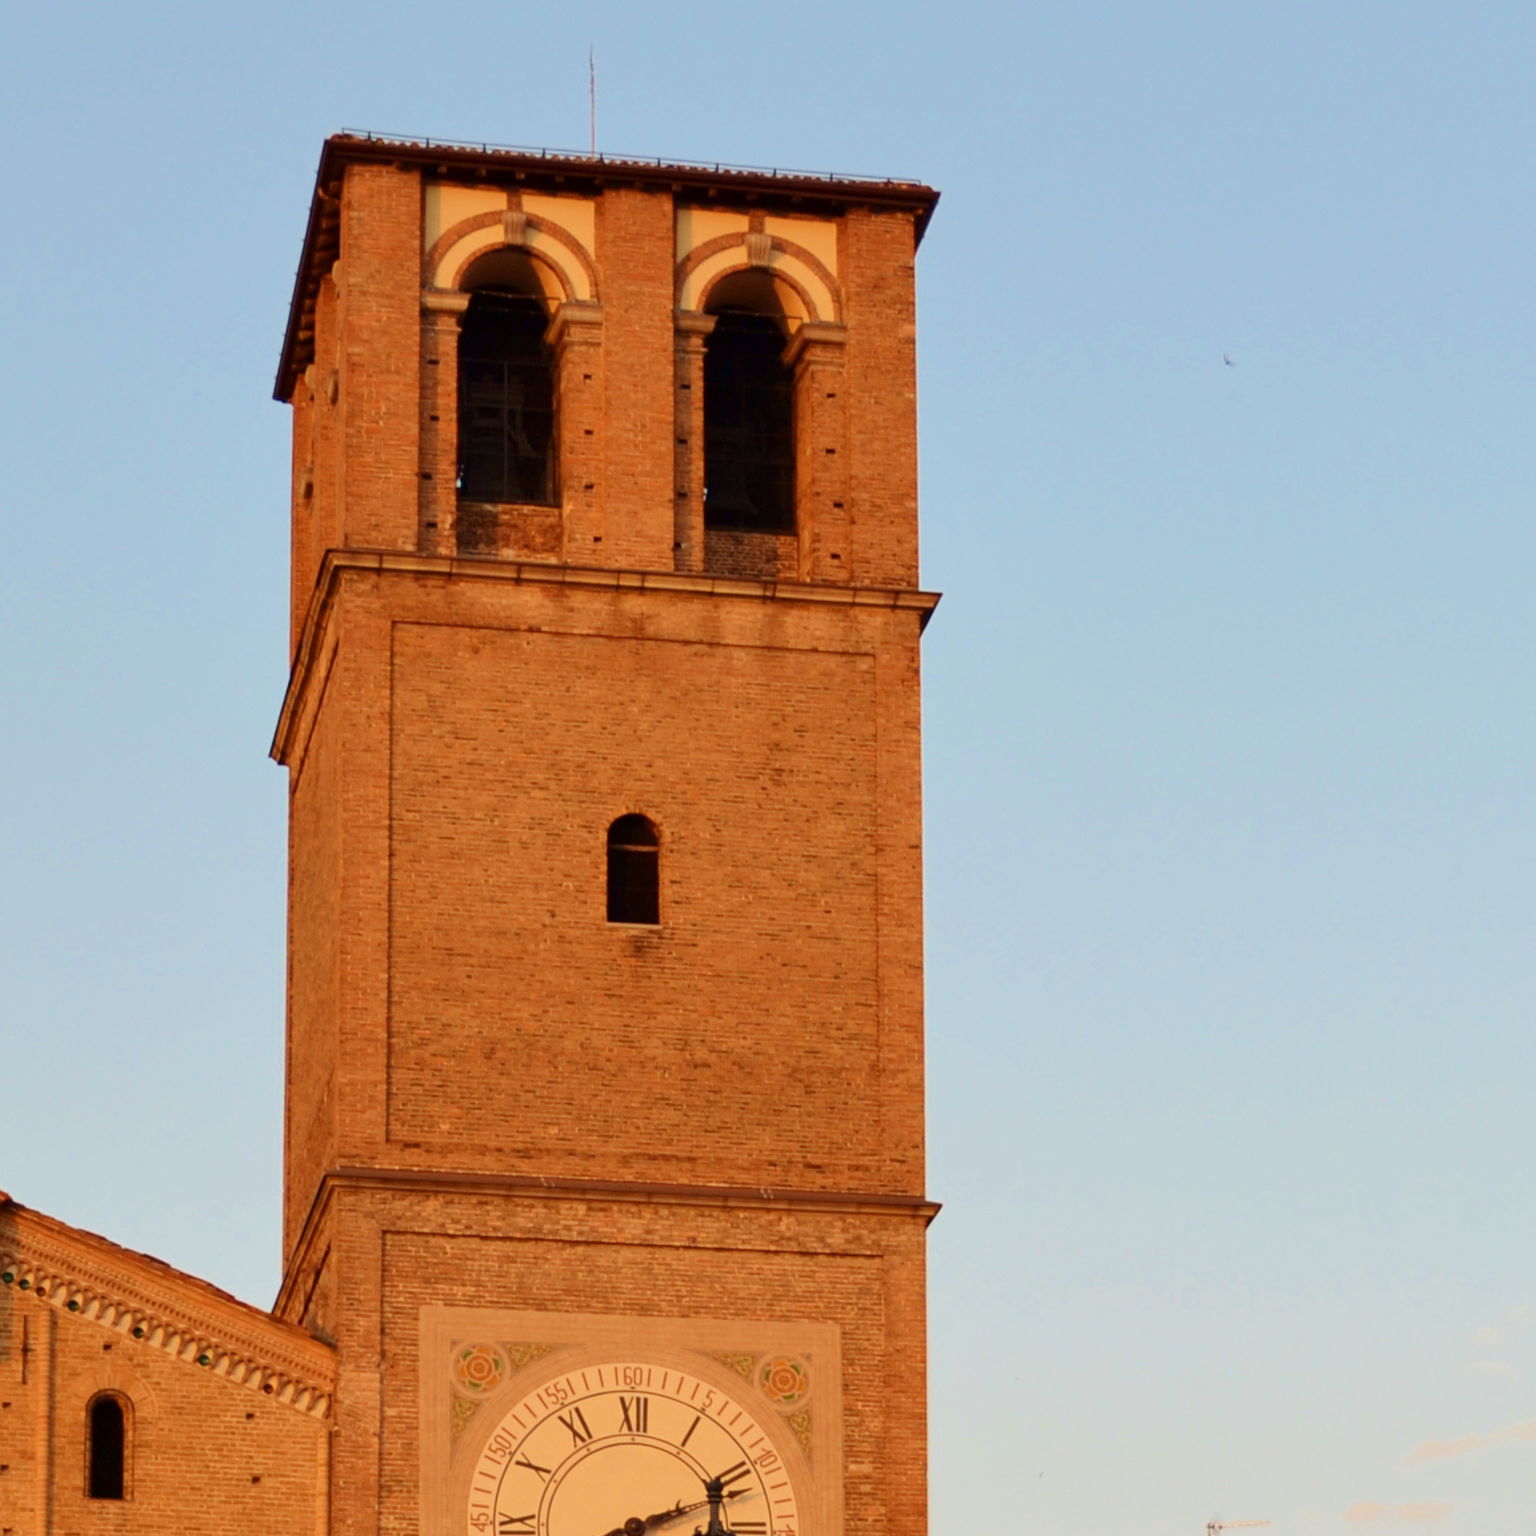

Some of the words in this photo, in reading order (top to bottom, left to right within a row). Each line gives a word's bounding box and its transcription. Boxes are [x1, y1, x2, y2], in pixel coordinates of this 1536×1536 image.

[623, 1366, 644, 1387] 60
[546, 1383, 569, 1404] 55
[702, 1389, 714, 1409] 5
[618, 1396, 649, 1434] XII
[557, 1406, 594, 1449] XI
[491, 1434, 513, 1459] 50
[758, 1447, 778, 1469] 10
[514, 1452, 552, 1484] X
[469, 1511, 490, 1532] 45
[499, 1512, 536, 1536] IX
